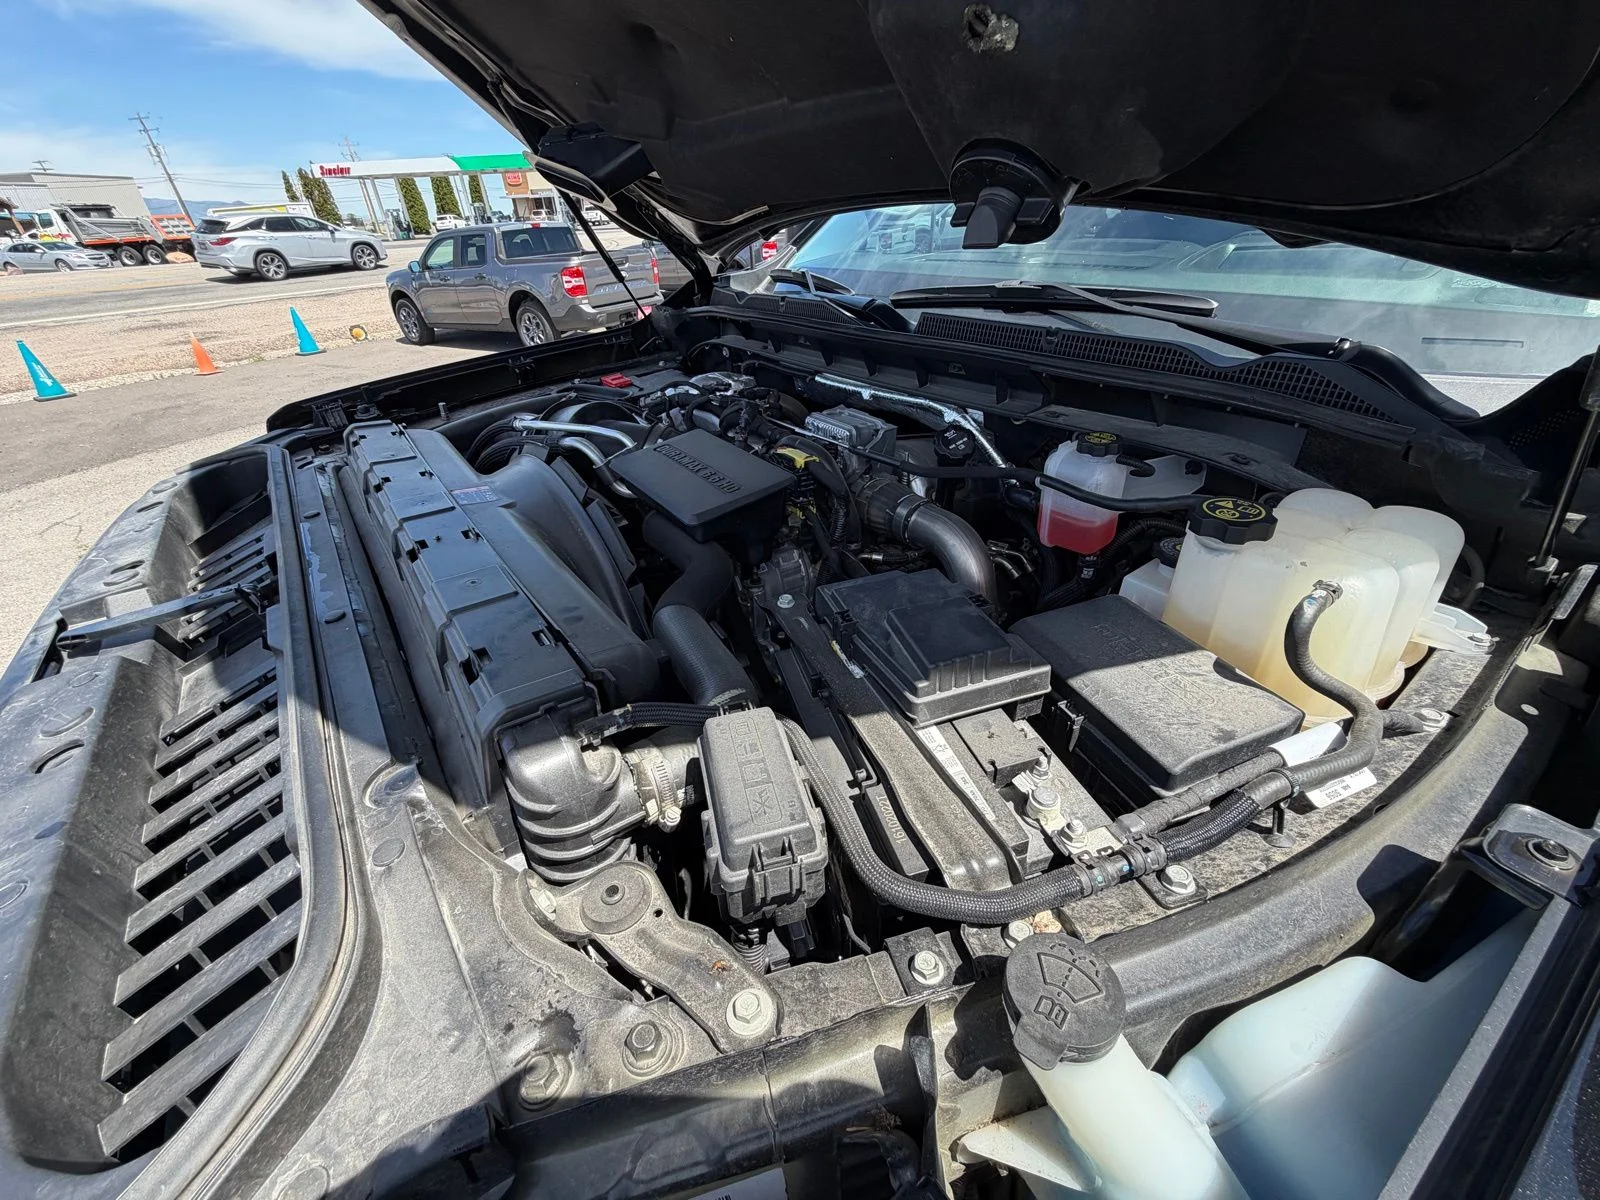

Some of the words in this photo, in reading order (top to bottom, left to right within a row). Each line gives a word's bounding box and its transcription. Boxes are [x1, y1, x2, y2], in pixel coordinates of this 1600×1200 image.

[319, 164, 351, 176] Sinclair
[656, 444, 708, 473] DURAMAX
[875, 795, 907, 844] 16102022T
